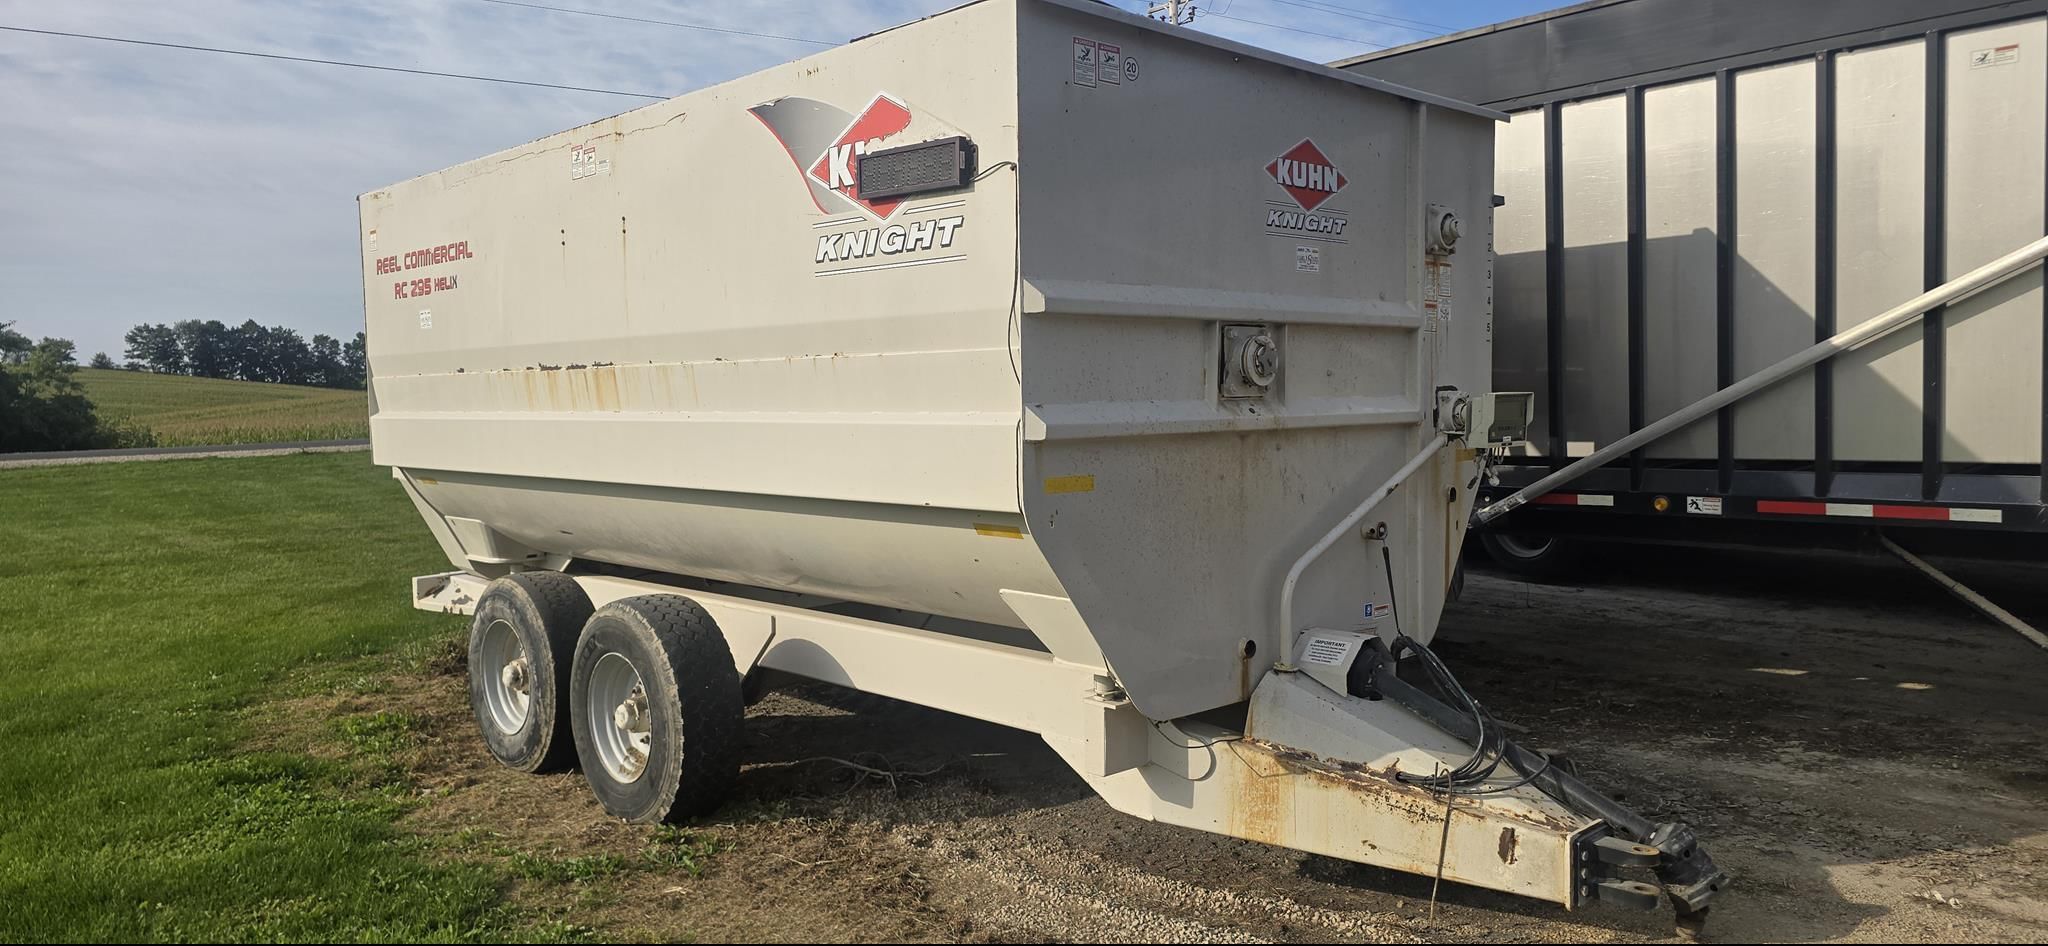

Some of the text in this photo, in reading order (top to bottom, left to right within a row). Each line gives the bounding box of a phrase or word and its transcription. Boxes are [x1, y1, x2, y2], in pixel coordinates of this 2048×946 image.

[1126, 61, 1137, 73] 20
[1277, 157, 1338, 193] KUHN
[1266, 209, 1347, 234] KNIGHT
[815, 215, 964, 264] KNIGHT
[376, 255, 401, 275] REEL
[404, 240, 473, 270] COMMERCIAL
[394, 275, 458, 300] RC 295 HELIX
[1314, 639, 1346, 647] IMPORTANT
